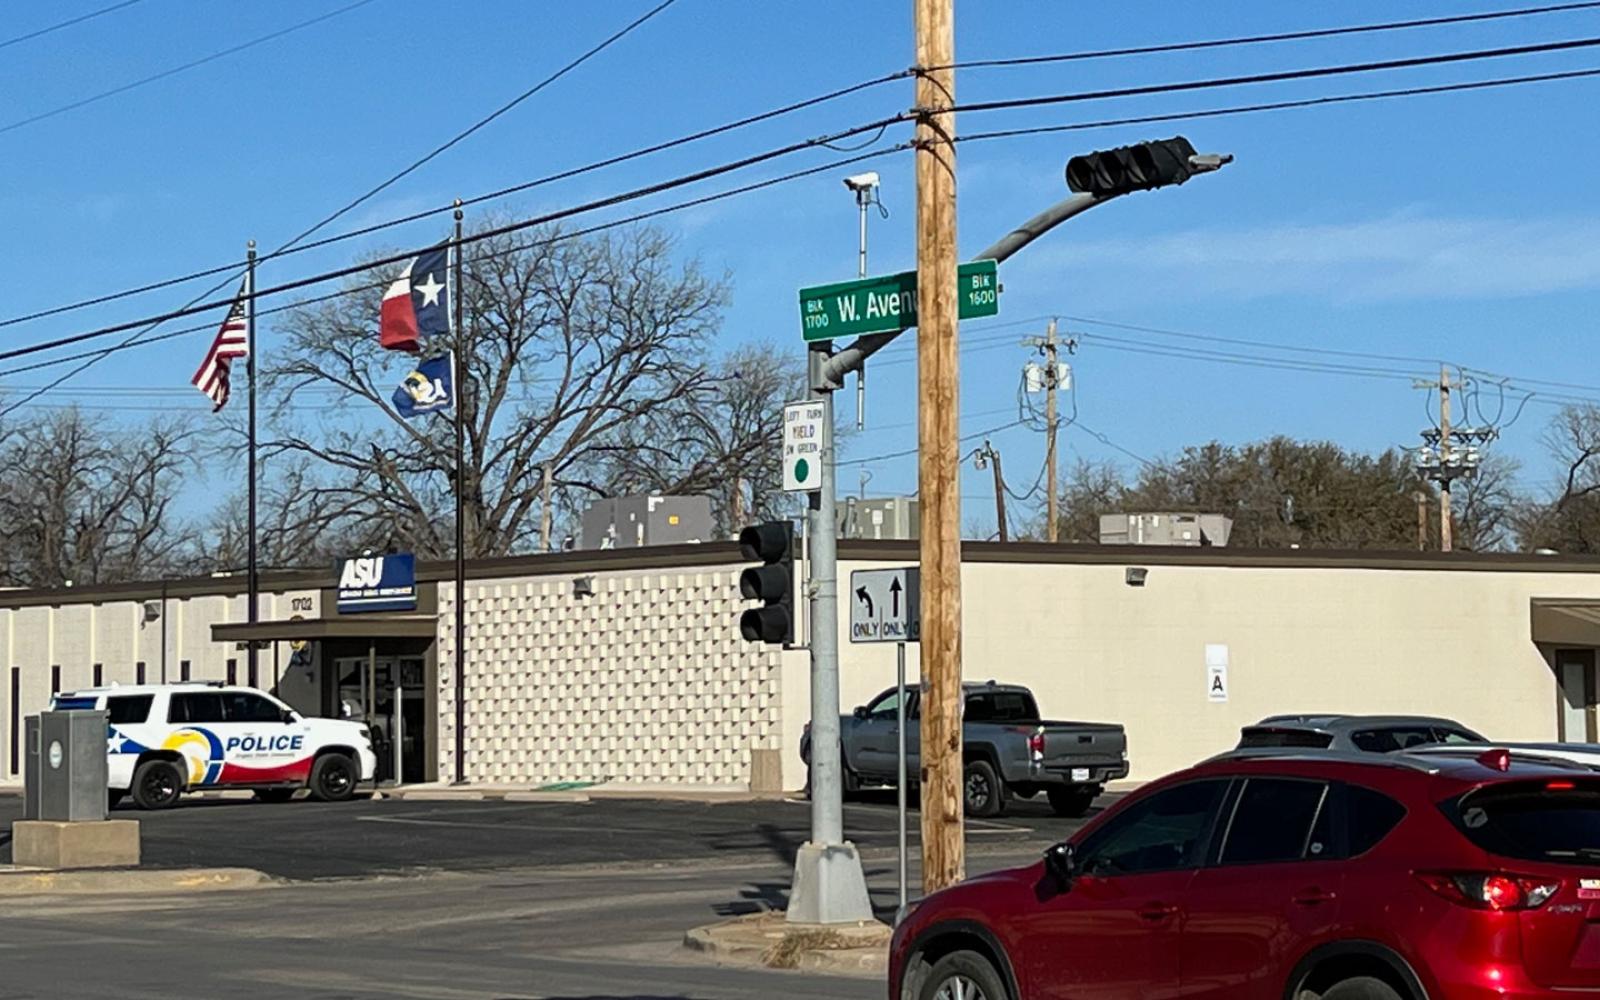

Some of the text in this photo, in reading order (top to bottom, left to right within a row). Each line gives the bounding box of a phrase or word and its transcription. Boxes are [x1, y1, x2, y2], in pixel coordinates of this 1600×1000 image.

[969, 289, 995, 306] 1600
[837, 294, 860, 322] W.
[805, 313, 829, 329] 1700
[340, 557, 384, 588] ASU
[853, 622, 879, 637] ONLY
[883, 621, 908, 636] ONLY
[1212, 674, 1224, 691] A
[226, 735, 304, 752] POLICE
